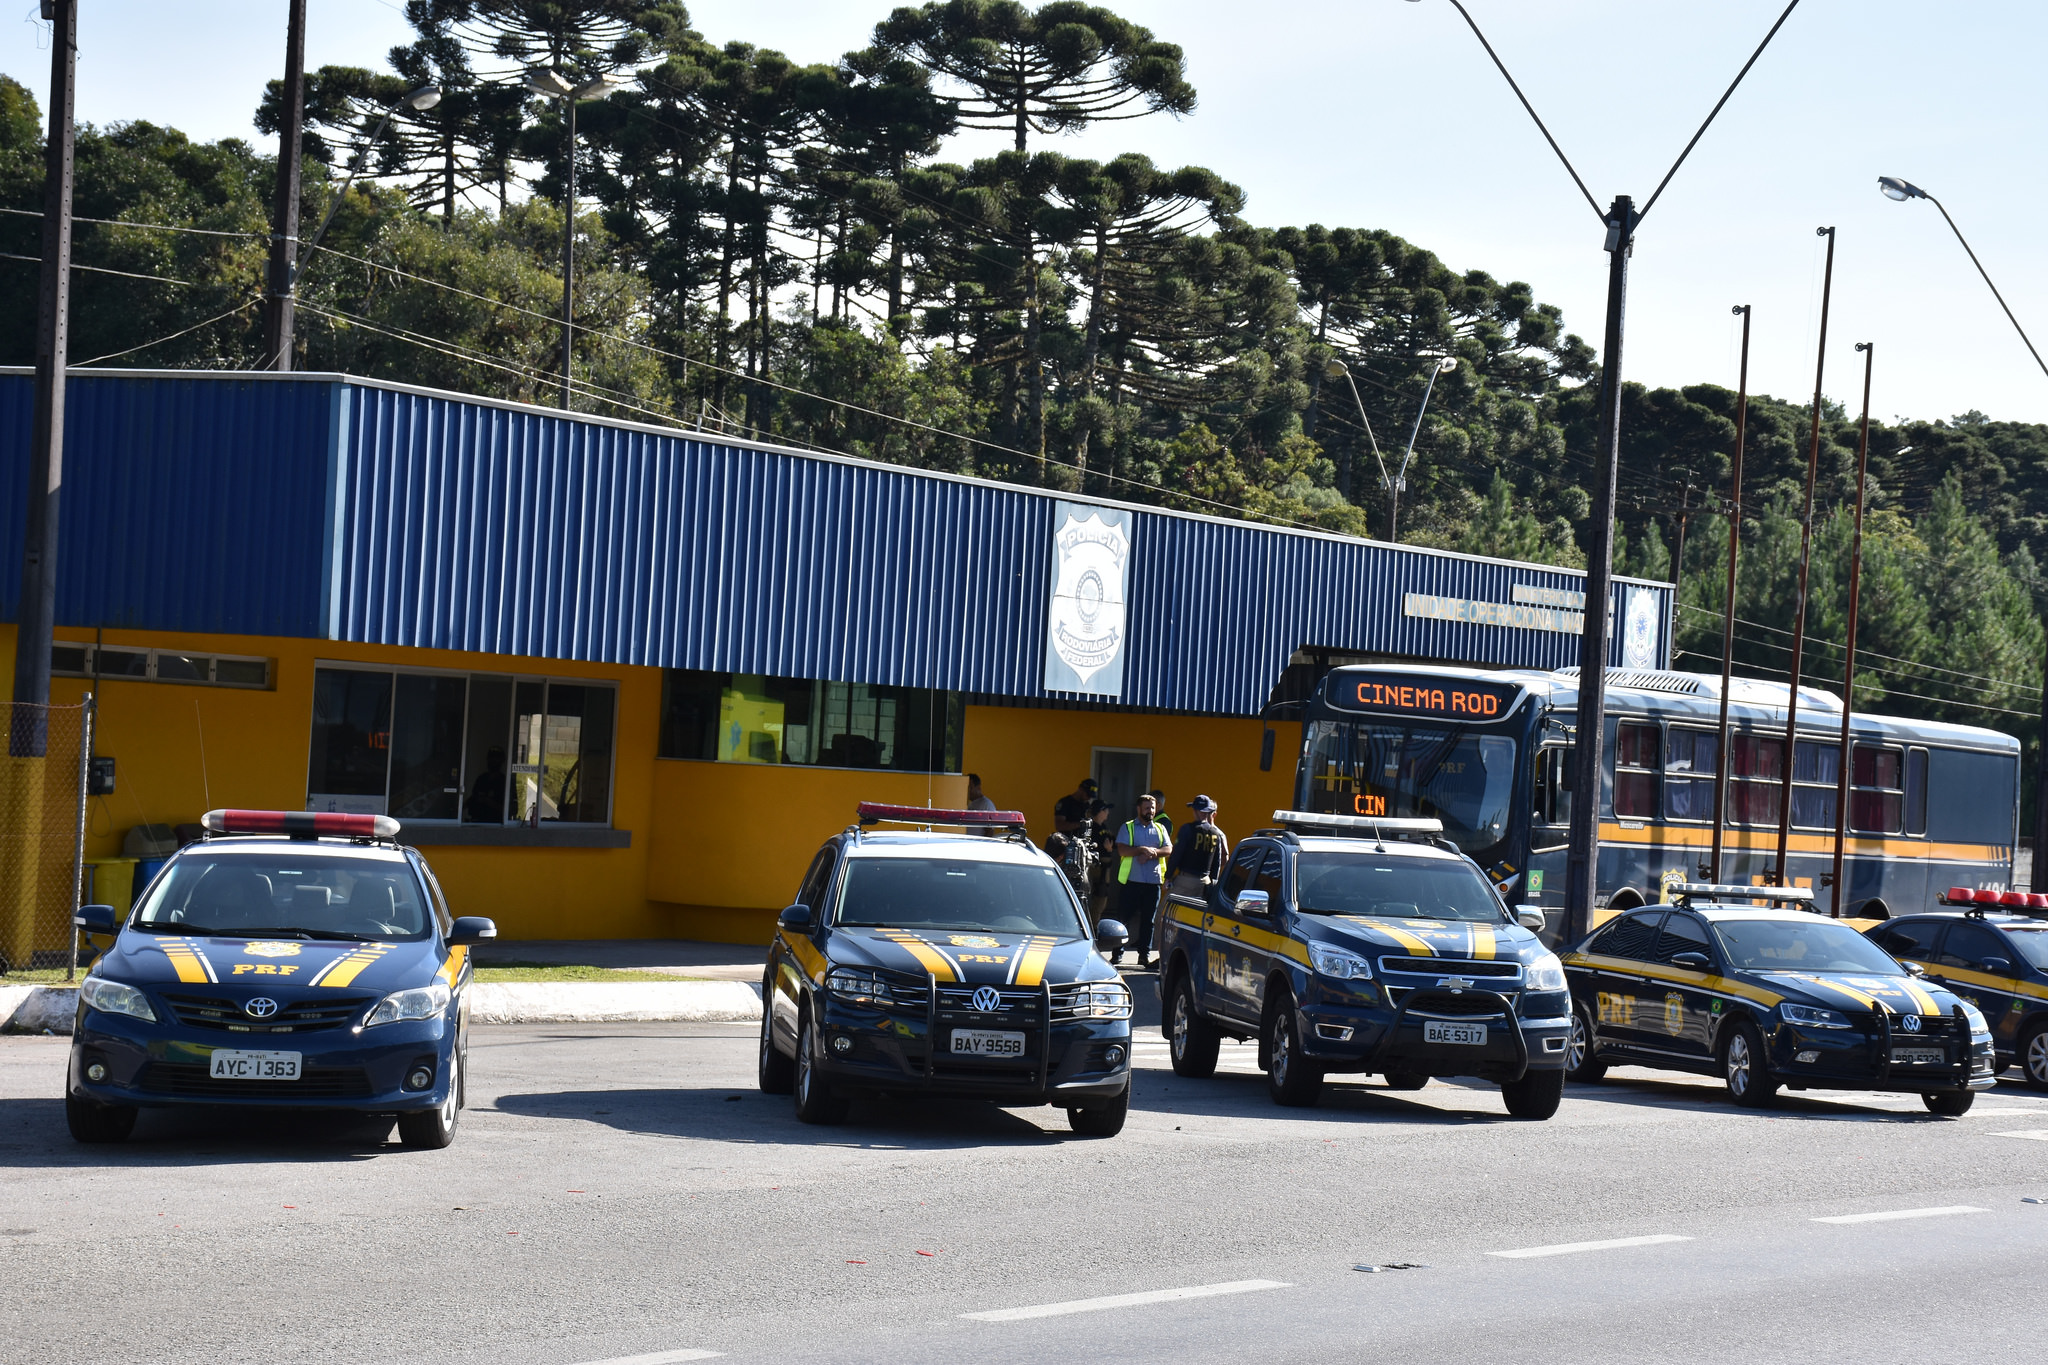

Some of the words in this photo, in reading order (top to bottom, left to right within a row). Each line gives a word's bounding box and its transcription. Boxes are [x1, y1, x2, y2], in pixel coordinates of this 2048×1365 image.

[1406, 595, 1465, 620] UNIDADE
[1469, 601, 1558, 630] OPERACIONAL
[1067, 653, 1103, 665] FEDERAL
[1357, 683, 1445, 710] CINEMA
[1452, 692, 1498, 715] ROD
[1354, 794, 1386, 816] CIN
[1195, 833, 1218, 853] PRF
[232, 964, 300, 976] PRF
[958, 954, 1009, 964] PRF
[1208, 949, 1227, 986] PRF
[1598, 992, 1635, 1025] PRF
